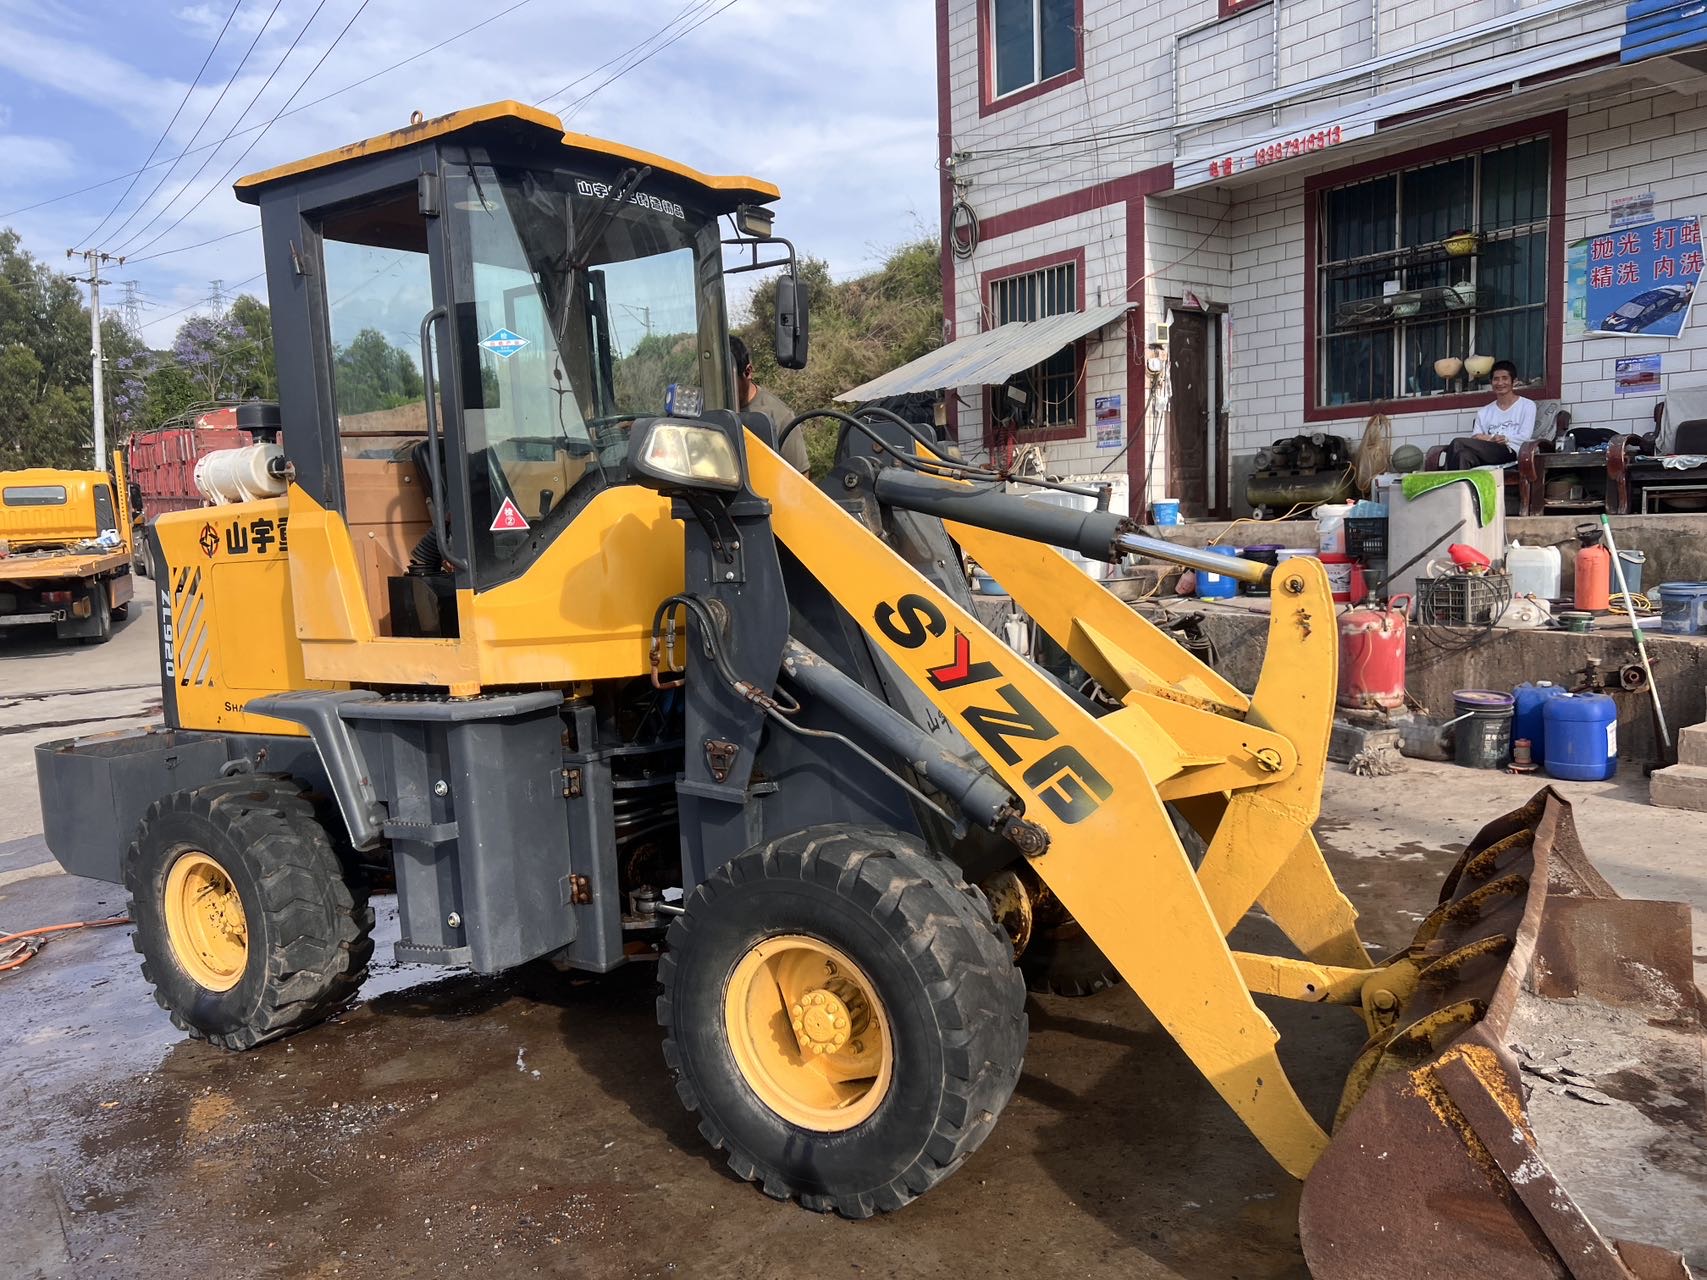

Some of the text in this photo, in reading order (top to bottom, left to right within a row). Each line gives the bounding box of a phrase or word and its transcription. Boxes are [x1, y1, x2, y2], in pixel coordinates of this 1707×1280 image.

[1590, 251, 1702, 290] 精洗 内洗
[1591, 221, 1701, 261] 抛光 打蜡
[161, 589, 175, 677] ZL920
[874, 593, 1114, 825] SYZG
